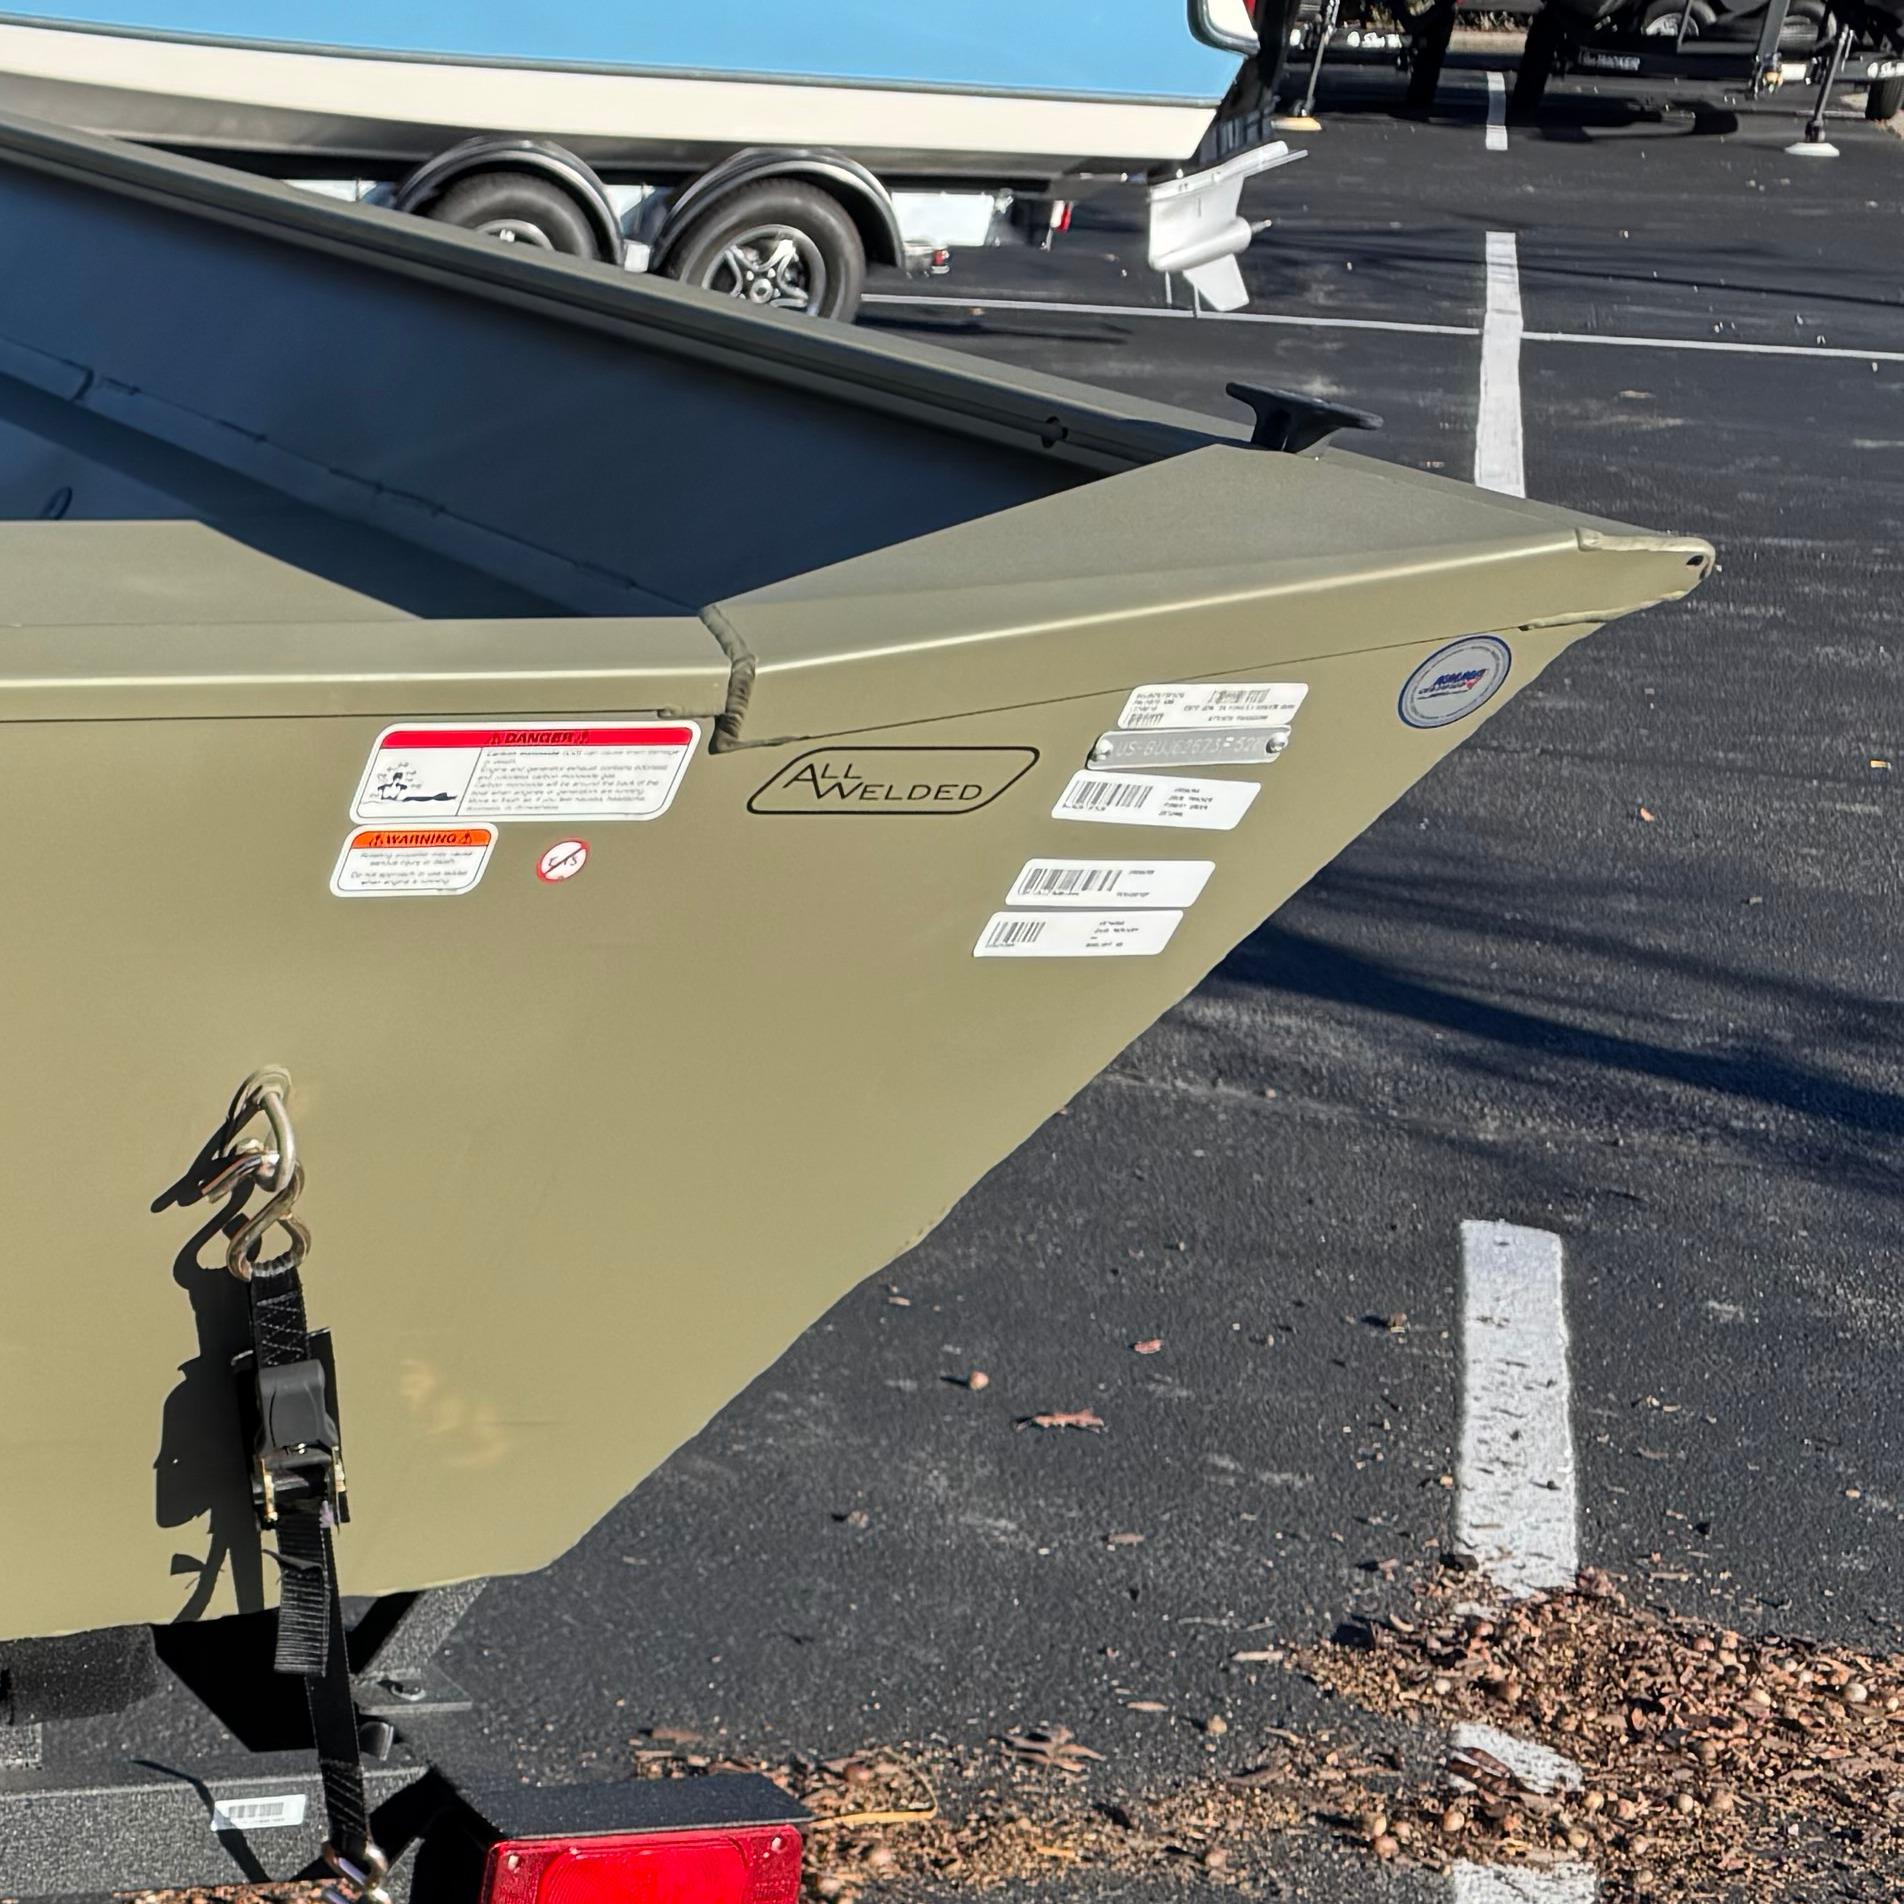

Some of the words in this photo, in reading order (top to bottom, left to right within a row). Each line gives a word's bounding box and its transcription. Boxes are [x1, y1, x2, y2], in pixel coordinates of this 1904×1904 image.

[504, 731, 573, 744] DANGER
[783, 763, 862, 788] ALL
[816, 781, 983, 801] WELDED
[386, 833, 457, 845] WARNING
